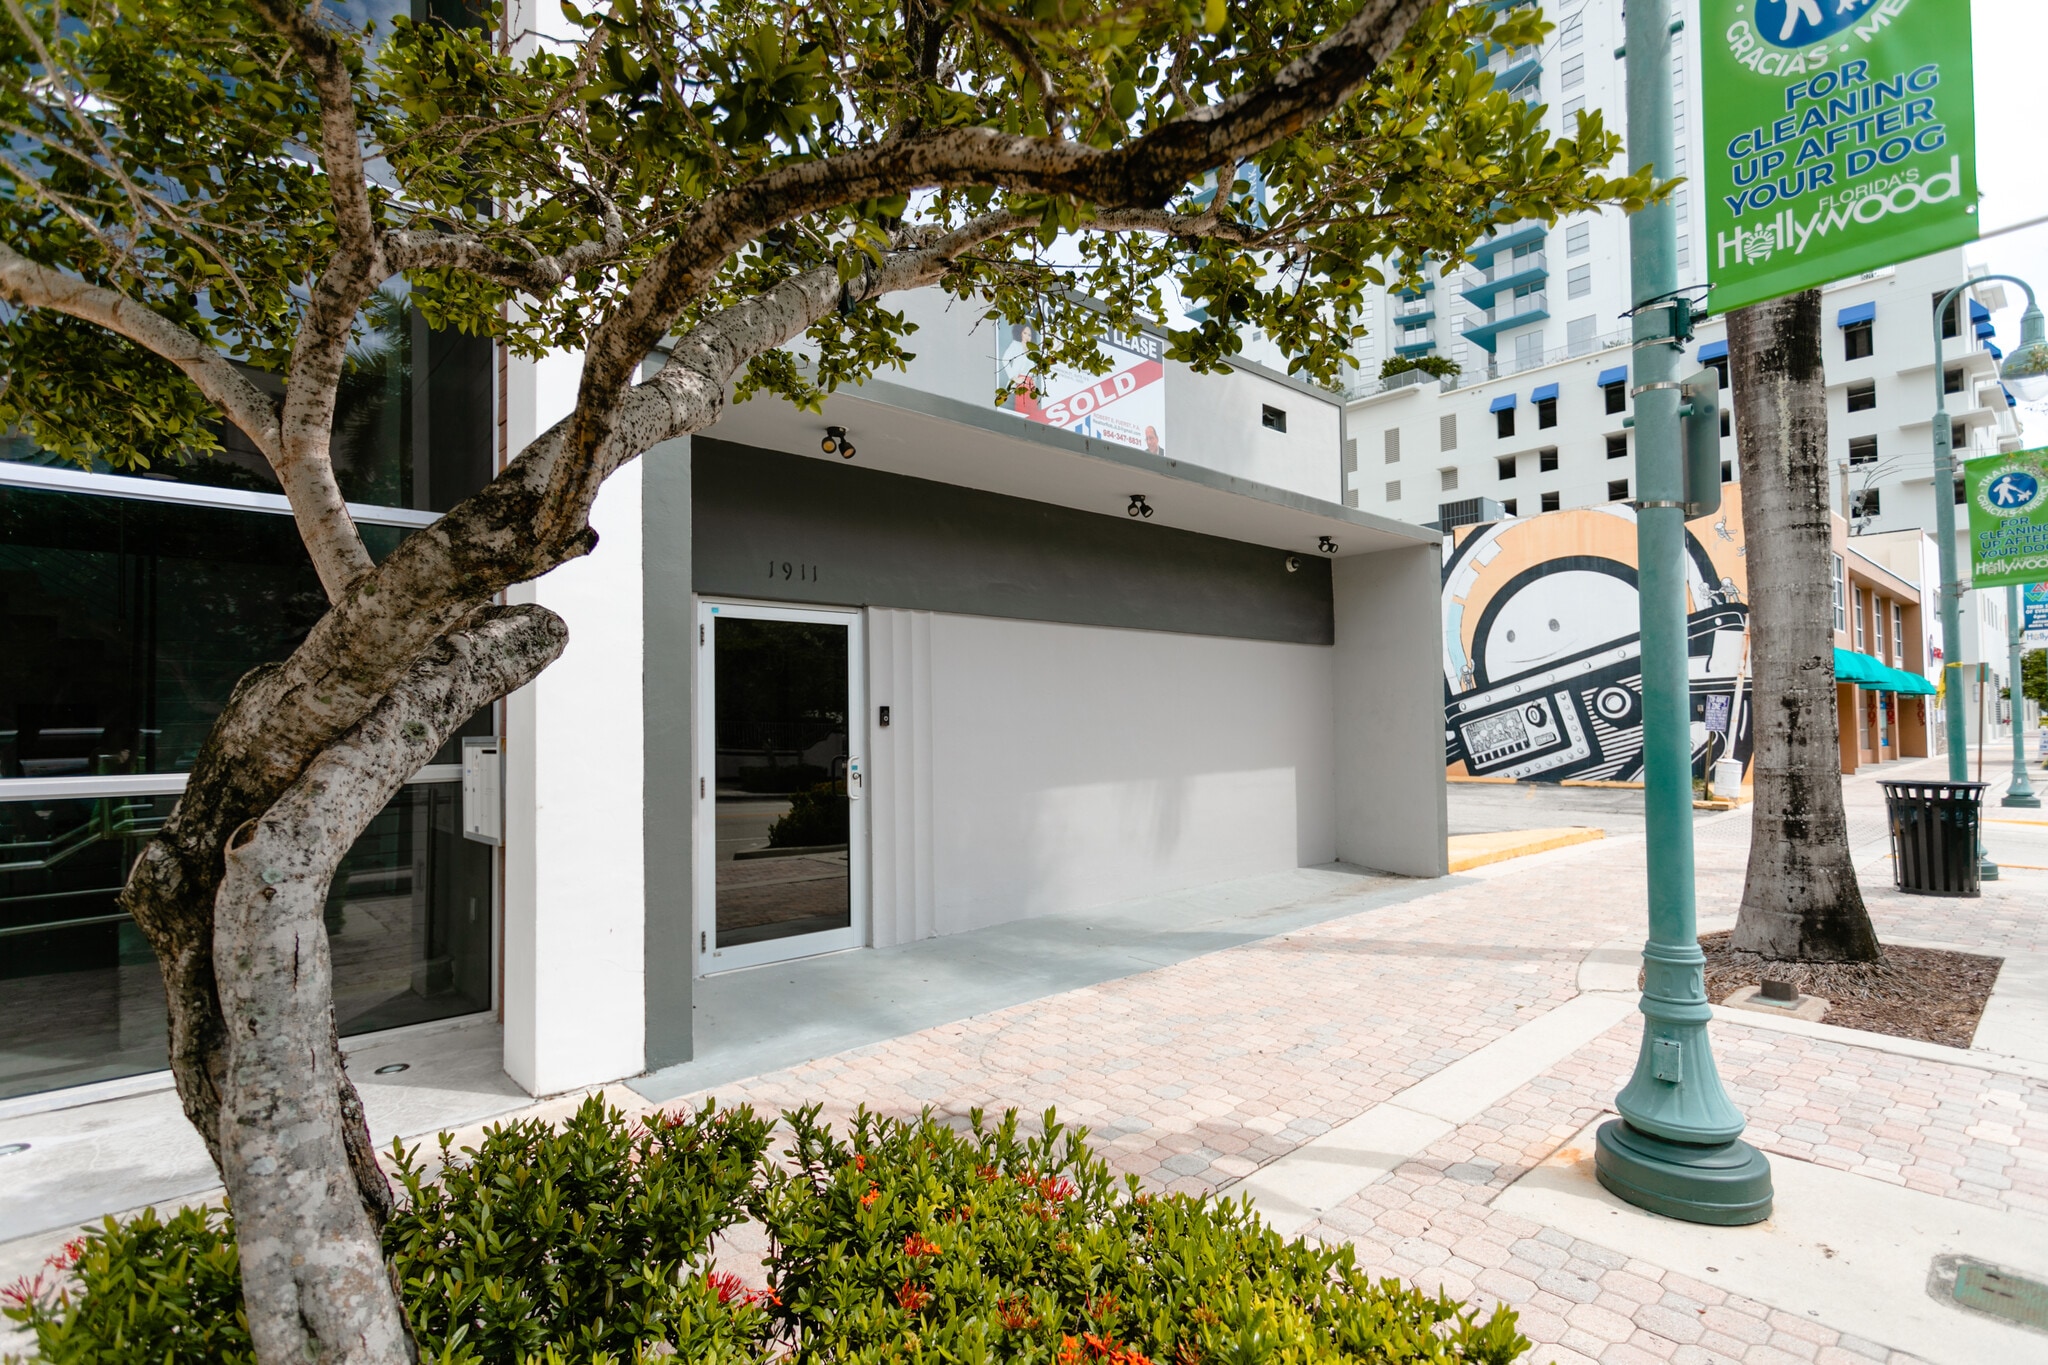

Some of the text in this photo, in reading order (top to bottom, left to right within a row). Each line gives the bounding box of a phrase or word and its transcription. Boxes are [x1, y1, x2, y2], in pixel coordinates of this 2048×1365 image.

[1726, 20, 1828, 76] GRACIAS
[1785, 58, 1870, 111] FOR
[1726, 64, 1940, 160] CLEANING
[1732, 97, 1936, 188] UP AFTER
[1723, 124, 1946, 218] YOUR DOG
[1819, 168, 1920, 212] FLORIDA'S
[1113, 328, 1158, 359] LEASE
[1046, 372, 1136, 428] SOLD
[1978, 464, 2019, 488] THANK
[1977, 495, 2016, 517] GRACIAS
[2001, 517, 2029, 528] FOR
[1978, 543, 2048, 559] YOUR DO
[1982, 540, 2001, 550] UP
[768, 560, 818, 582] 1911
